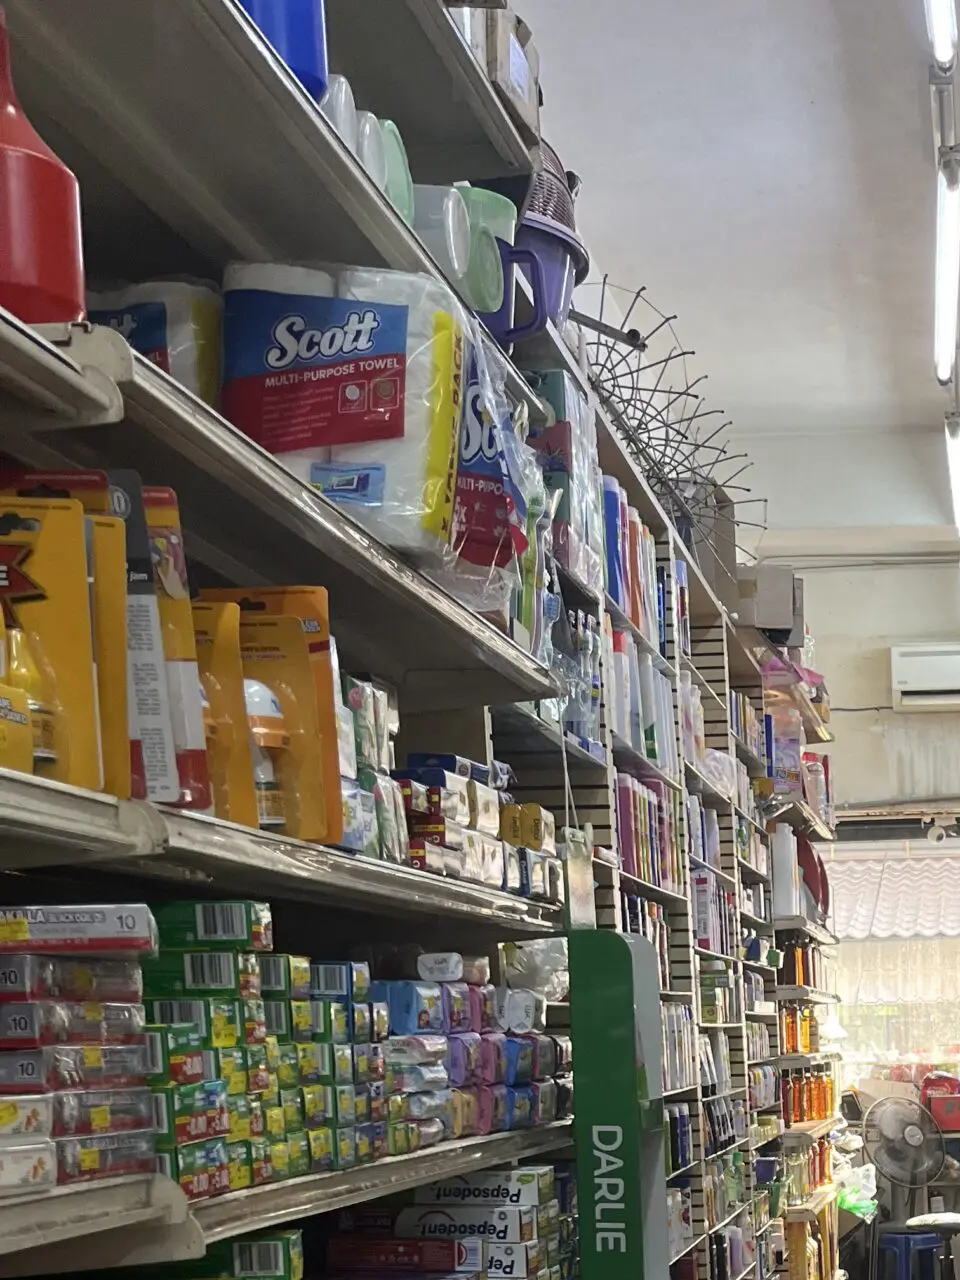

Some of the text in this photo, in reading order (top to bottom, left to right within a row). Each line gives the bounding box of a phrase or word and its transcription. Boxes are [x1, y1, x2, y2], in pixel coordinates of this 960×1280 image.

[265, 310, 380, 370] Scott
[264, 357, 401, 388] MULTI-PURPOSE TOWEL
[116, 914, 136, 931] 10
[1, 970, 18, 985] 10
[11, 1016, 28, 1031] 10
[18, 1062, 35, 1078] 10
[435, 1186, 522, 1204] Pepsodent
[592, 1125, 627, 1253] DARLIE
[421, 1220, 509, 1240] Pepsodent
